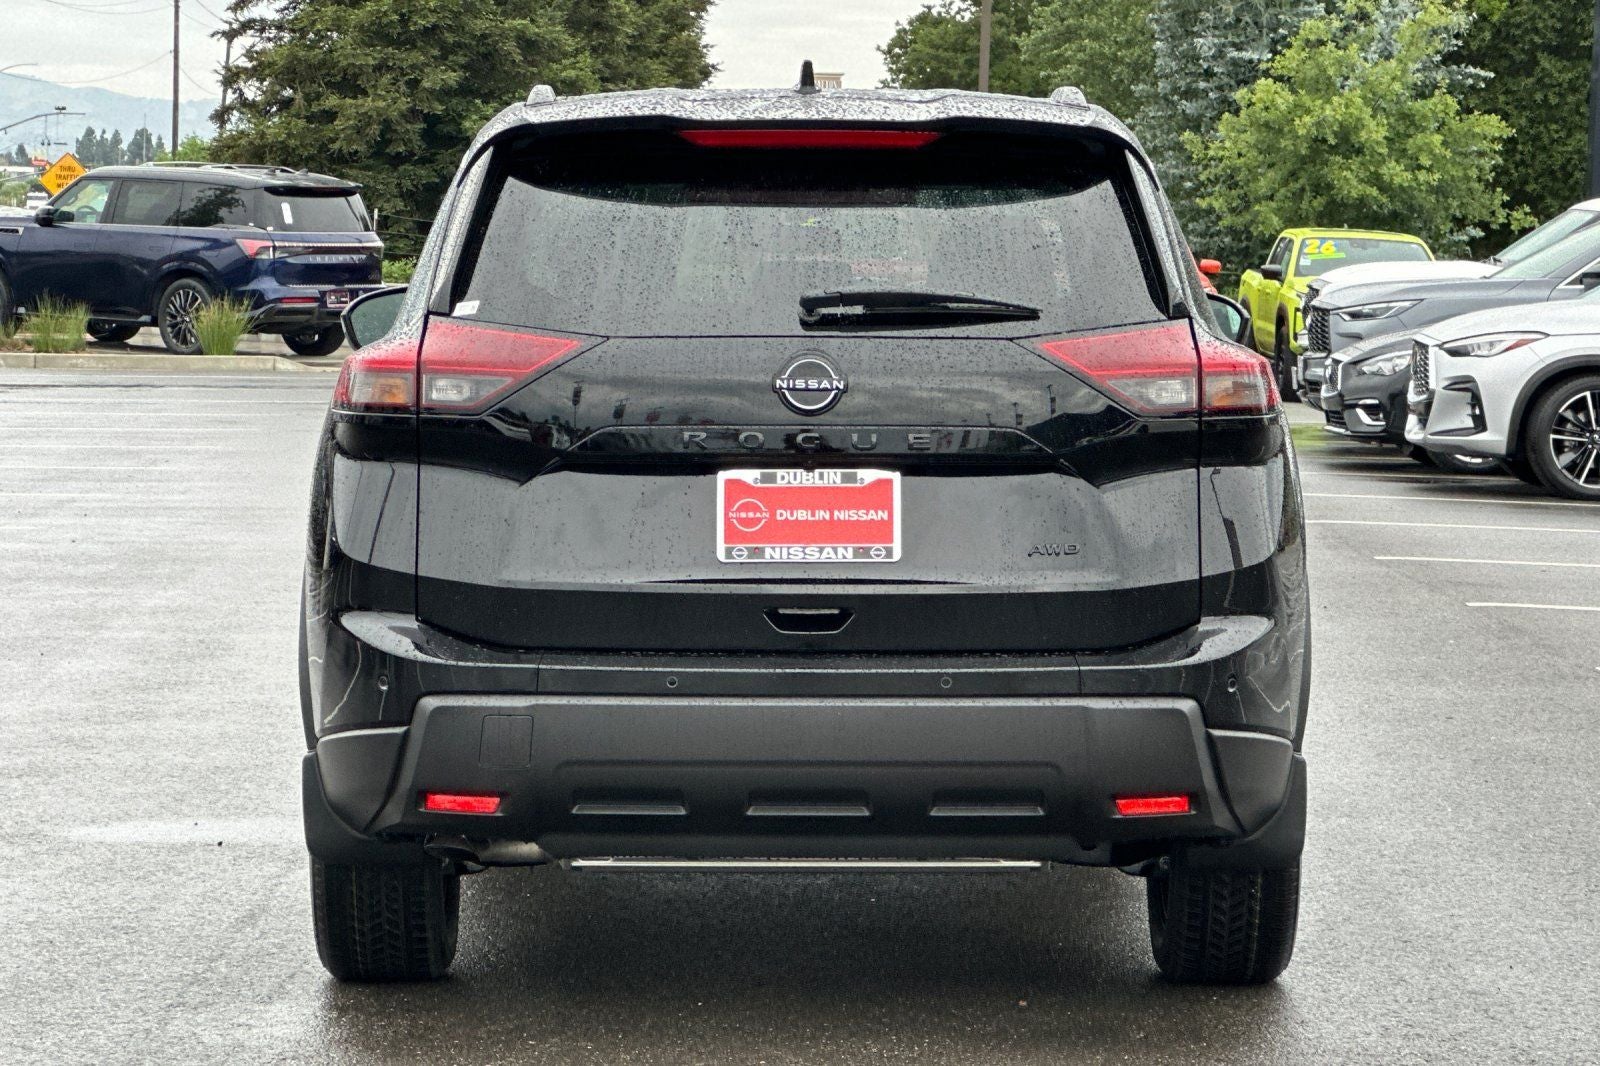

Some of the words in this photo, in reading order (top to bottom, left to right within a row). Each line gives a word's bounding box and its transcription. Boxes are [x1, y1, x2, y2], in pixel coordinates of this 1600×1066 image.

[1304, 239, 1336, 256] 26
[775, 379, 845, 390] NISSAN
[682, 431, 932, 451] ROGUE
[776, 471, 842, 484] DUBLIN
[728, 511, 770, 519] NISSAN
[776, 509, 830, 521] DUBLIN
[833, 509, 889, 521] NISSAN
[764, 547, 854, 560] NISSAN
[1027, 543, 1080, 557] AWD
